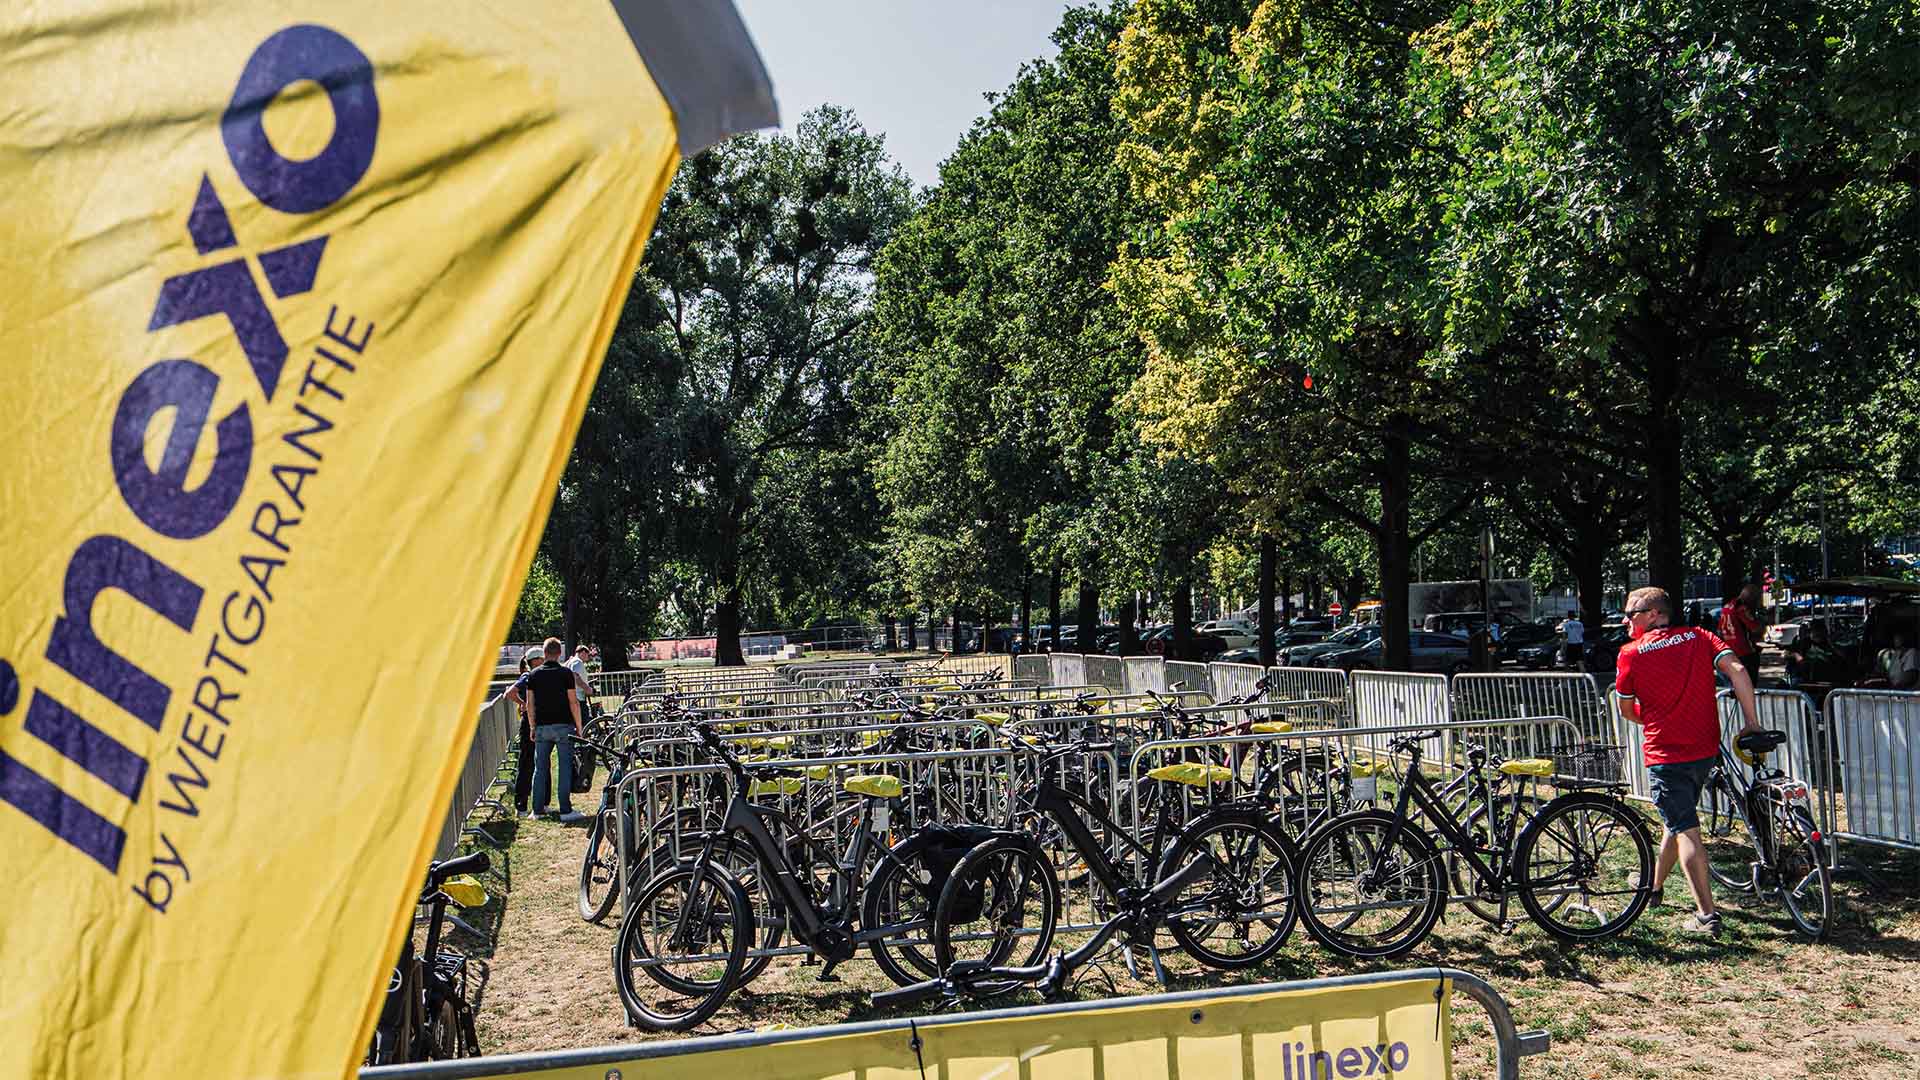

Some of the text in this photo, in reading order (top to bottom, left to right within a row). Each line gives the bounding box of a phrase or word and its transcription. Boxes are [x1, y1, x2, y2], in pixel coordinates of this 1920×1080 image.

[0, 23, 380, 875] linexo
[131, 303, 376, 914] by WERTGARANTIE
[1281, 1041, 1409, 1080] linexo
